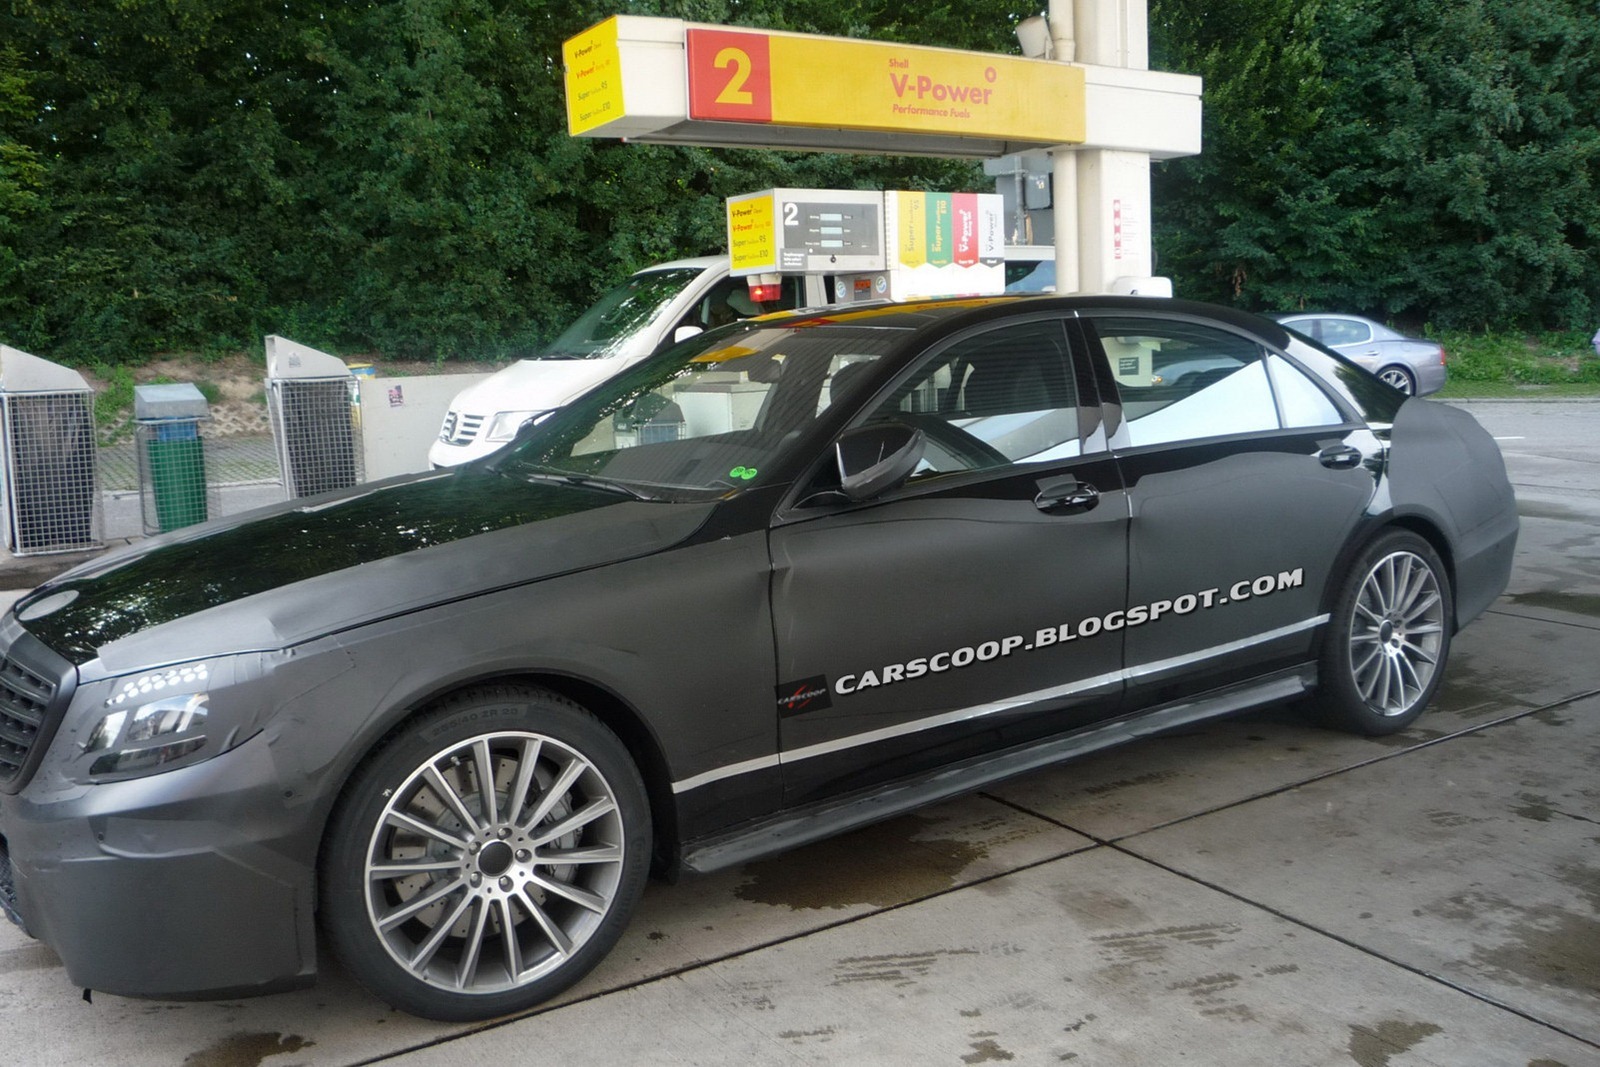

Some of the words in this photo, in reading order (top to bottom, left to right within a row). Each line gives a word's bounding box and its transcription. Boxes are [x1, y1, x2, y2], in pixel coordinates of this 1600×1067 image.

[713, 46, 754, 105] 2
[889, 58, 909, 69] Shell
[889, 72, 993, 105] V-Power
[892, 103, 949, 118] Performance
[949, 107, 971, 119] Fuels
[784, 202, 799, 226] 2
[935, 225, 943, 252] Super
